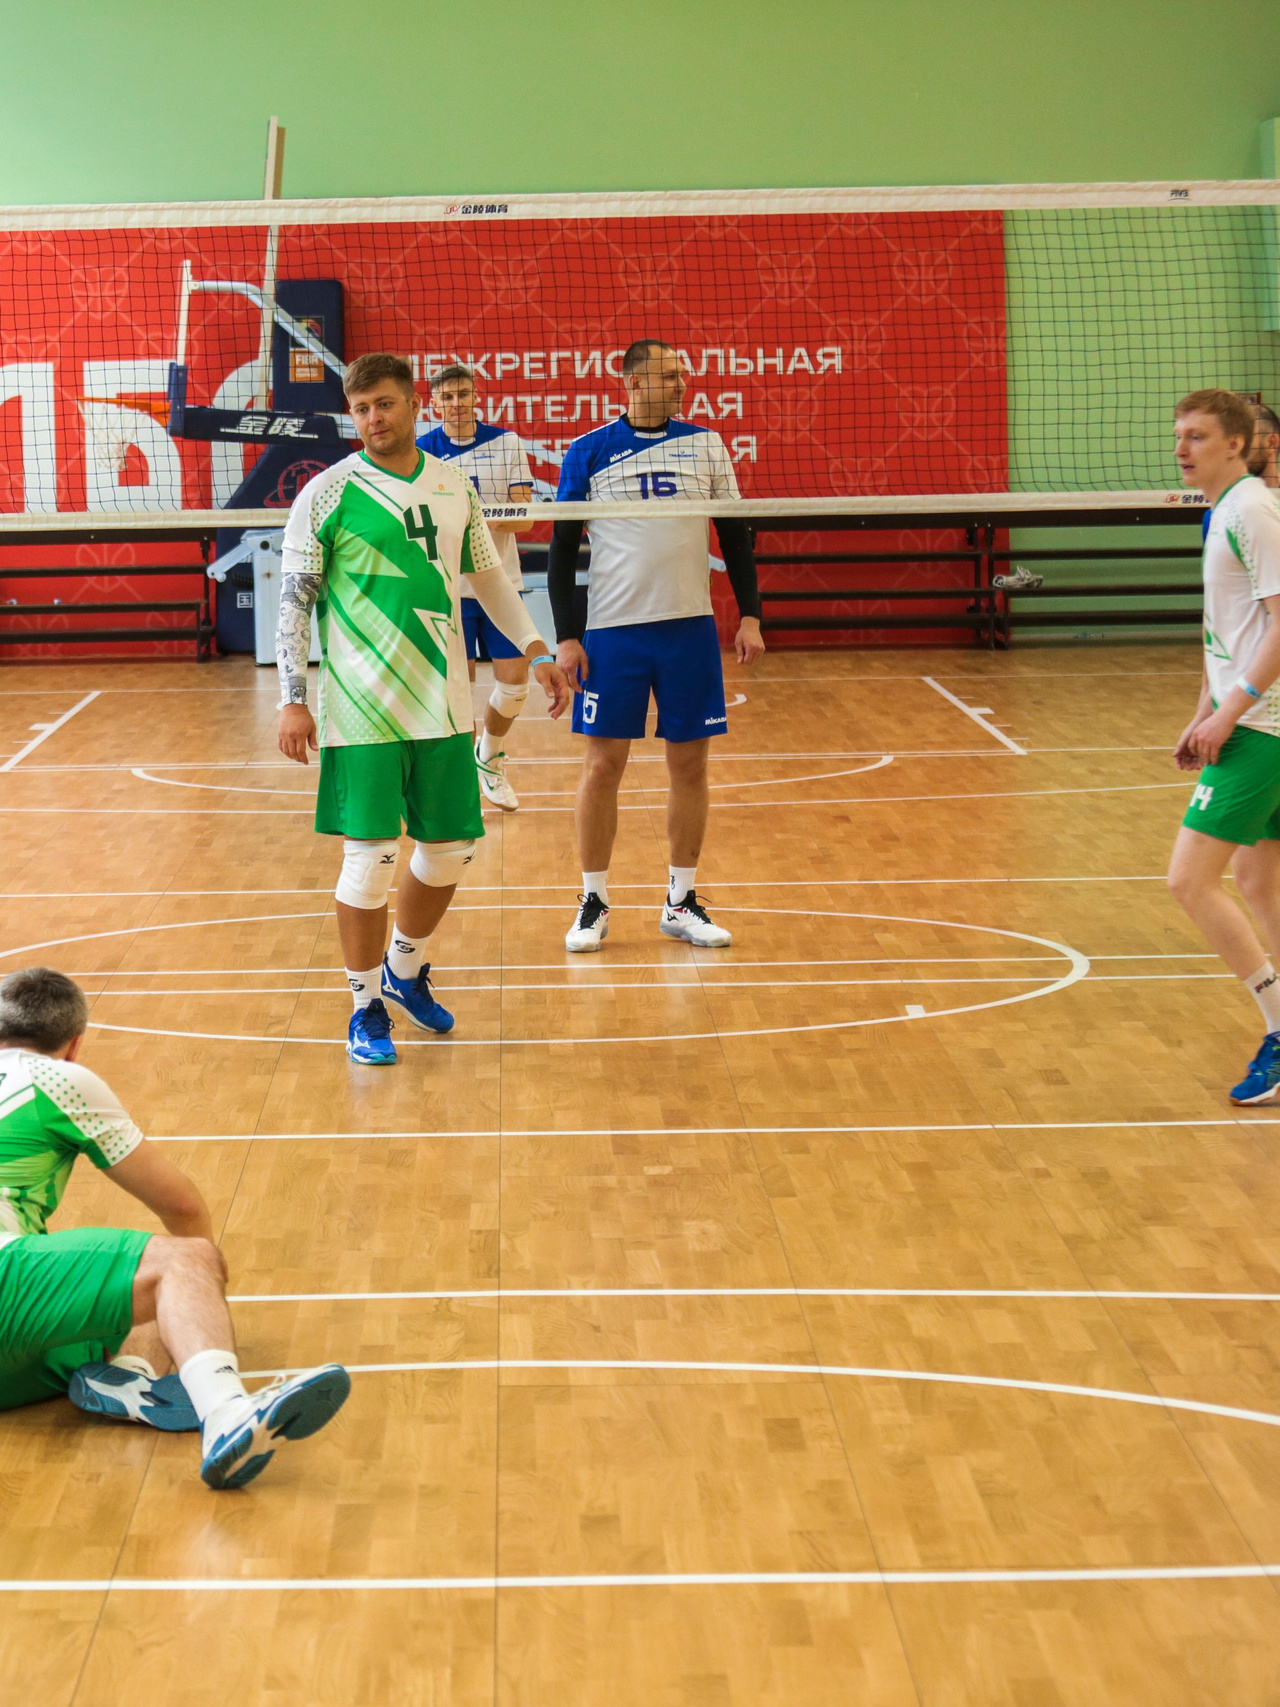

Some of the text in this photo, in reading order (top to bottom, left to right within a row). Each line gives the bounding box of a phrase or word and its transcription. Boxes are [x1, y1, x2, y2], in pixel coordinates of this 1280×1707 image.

[407, 346, 842, 382] ЕЖРЕГИОАЛЬНАЯ
[224, 415, 316, 438] 金陵
[402, 503, 439, 562] 4
[1189, 784, 1214, 811] 14
